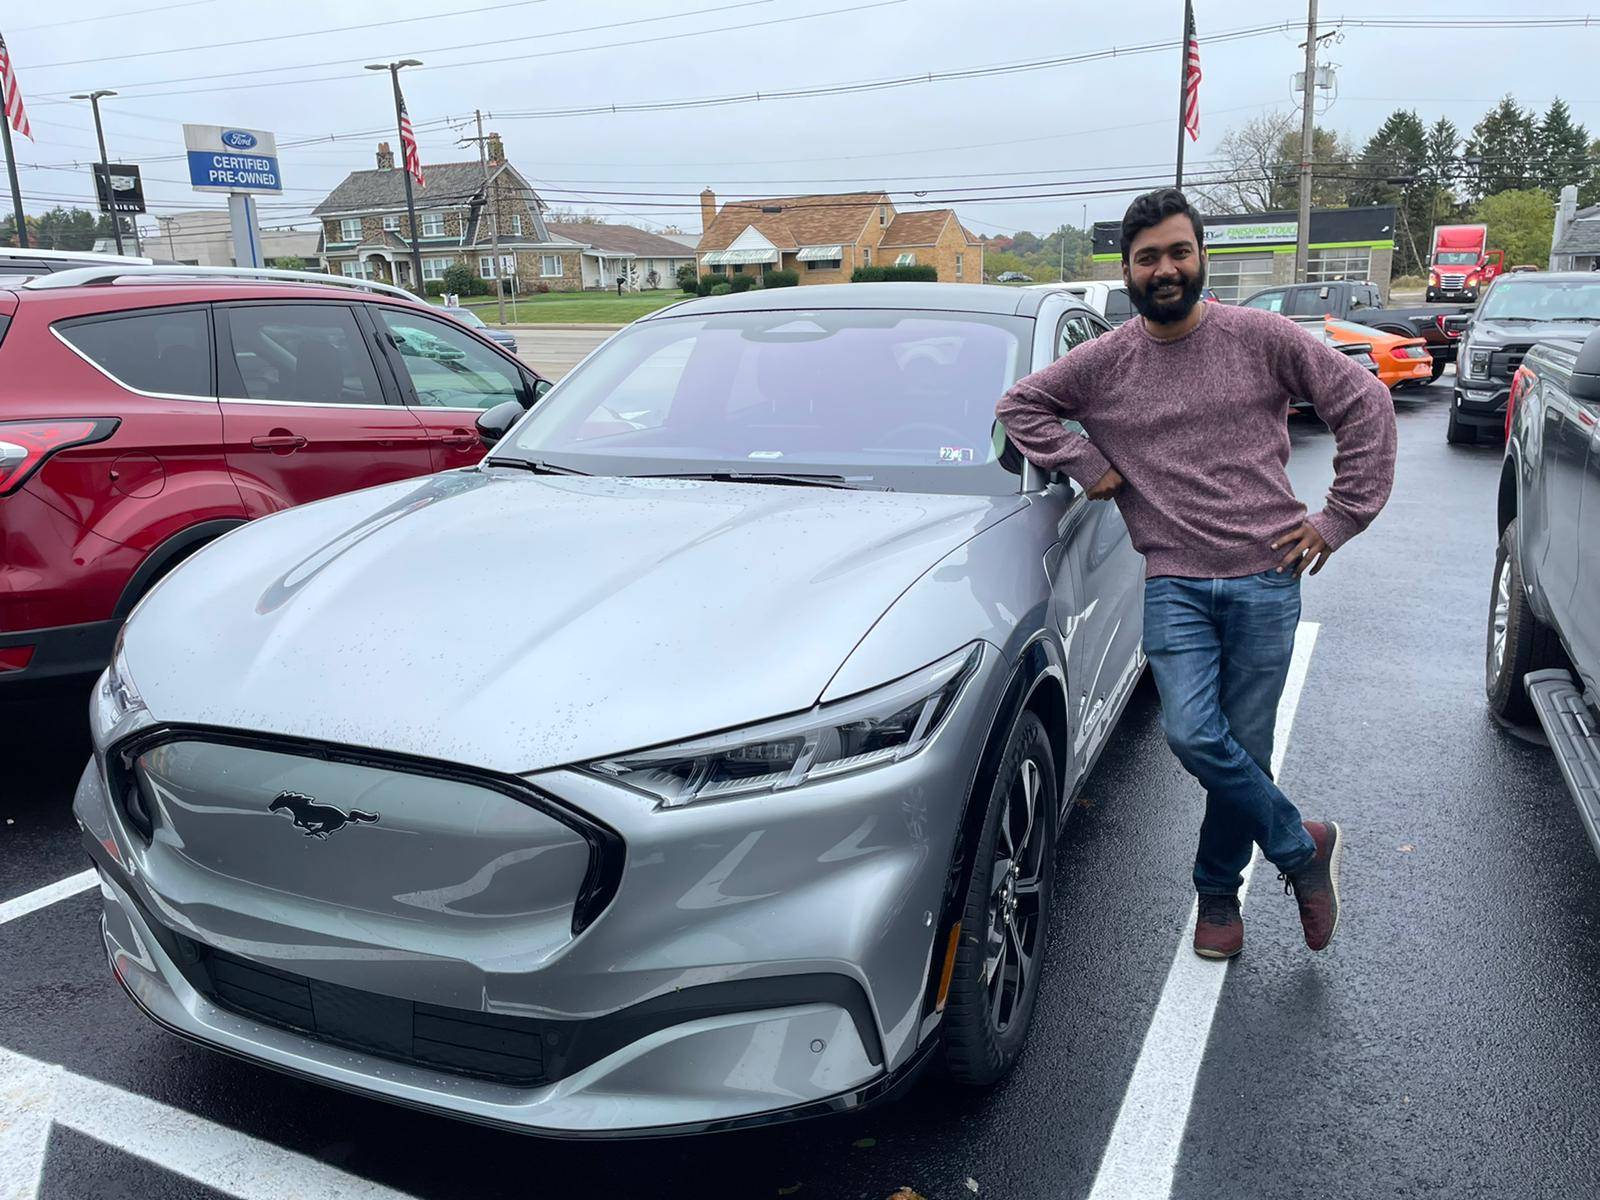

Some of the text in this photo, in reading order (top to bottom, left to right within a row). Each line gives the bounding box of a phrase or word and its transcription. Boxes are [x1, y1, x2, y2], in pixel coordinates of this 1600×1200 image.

[231, 132, 252, 146] Ford
[213, 156, 270, 171] CERTIFIED
[209, 170, 275, 185] PRE-OWNED
[1270, 225, 1298, 234] TOUC
